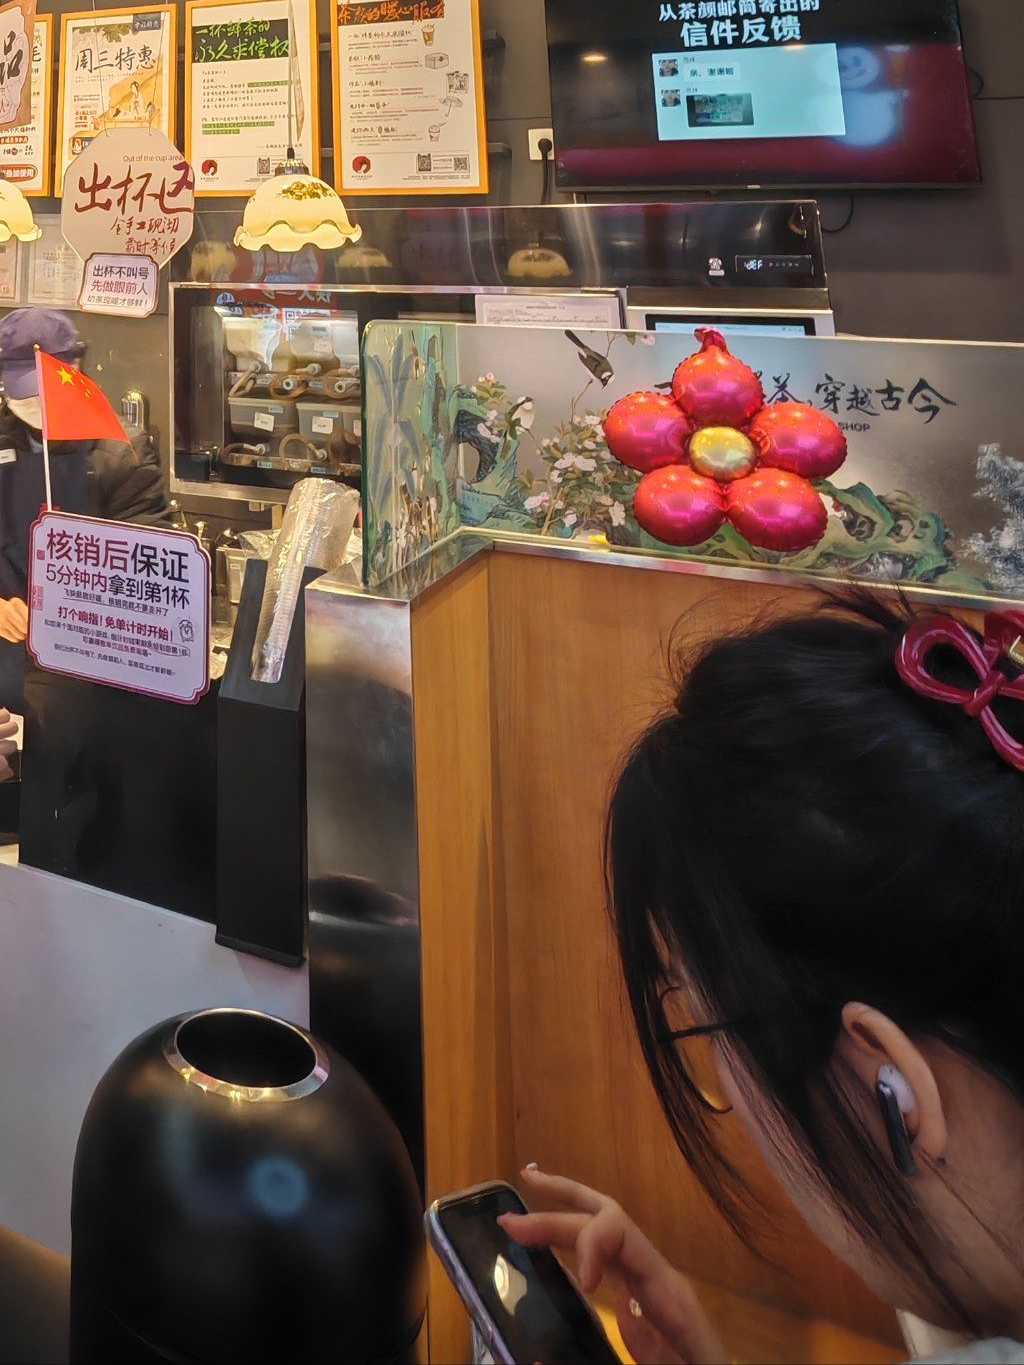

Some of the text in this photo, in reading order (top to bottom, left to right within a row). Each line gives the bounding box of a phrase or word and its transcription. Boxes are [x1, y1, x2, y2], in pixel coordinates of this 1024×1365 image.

[680, 14, 802, 48] 信件反馈
[75, 44, 156, 75] 周三特惠
[136, 154, 144, 162] of
[145, 154, 156, 162] the
[156, 156, 168, 164] cup
[74, 162, 195, 216] 出杯区
[90, 279, 149, 296] 先做眼前人
[92, 264, 150, 281] 出杯不叫号
[45, 527, 190, 584] 核销后保证
[45, 563, 190, 610] 5分钟内拿到第1杯
